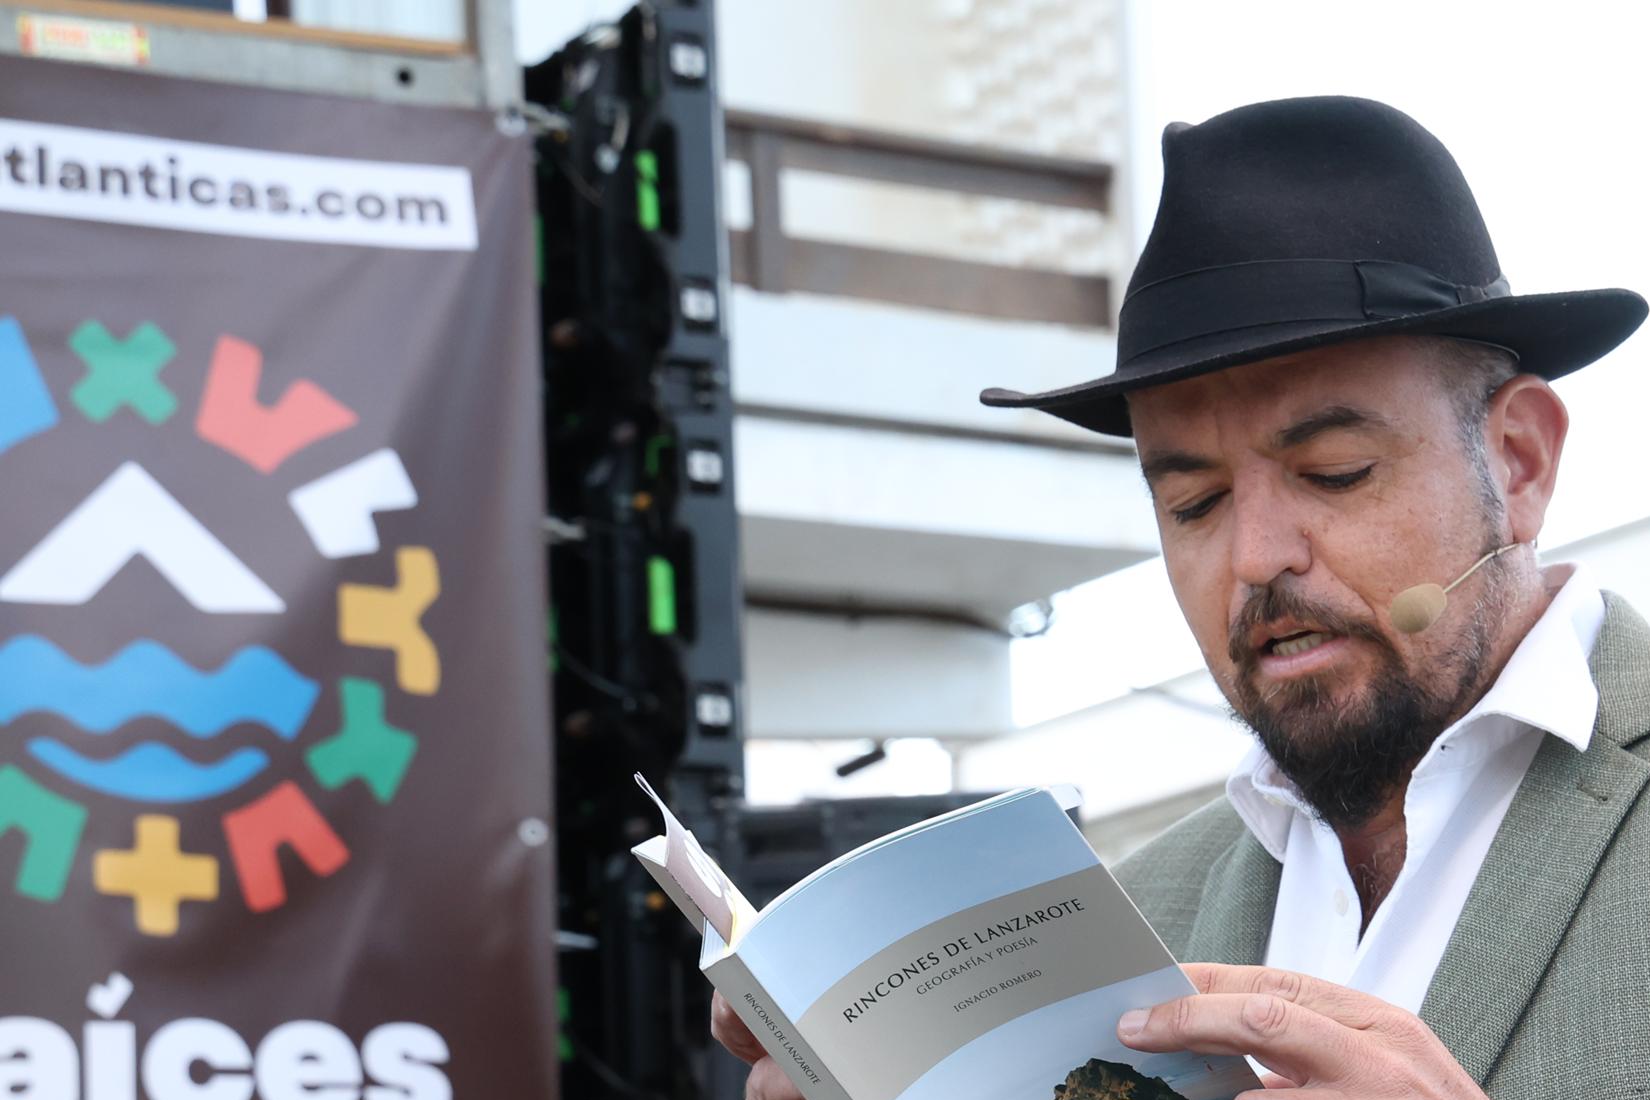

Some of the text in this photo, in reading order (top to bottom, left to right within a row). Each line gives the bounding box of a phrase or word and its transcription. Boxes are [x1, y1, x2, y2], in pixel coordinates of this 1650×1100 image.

[4, 145, 450, 225] tlanticas.com
[842, 898, 1085, 1023] RINCONES DE LANZAROTE
[916, 937, 1038, 995] GEOGRAFÍA Y POESÍA
[953, 968, 1042, 1013] IGNACIO ROMERO
[743, 992, 821, 1085] RINCONES DE LANZAROTE
